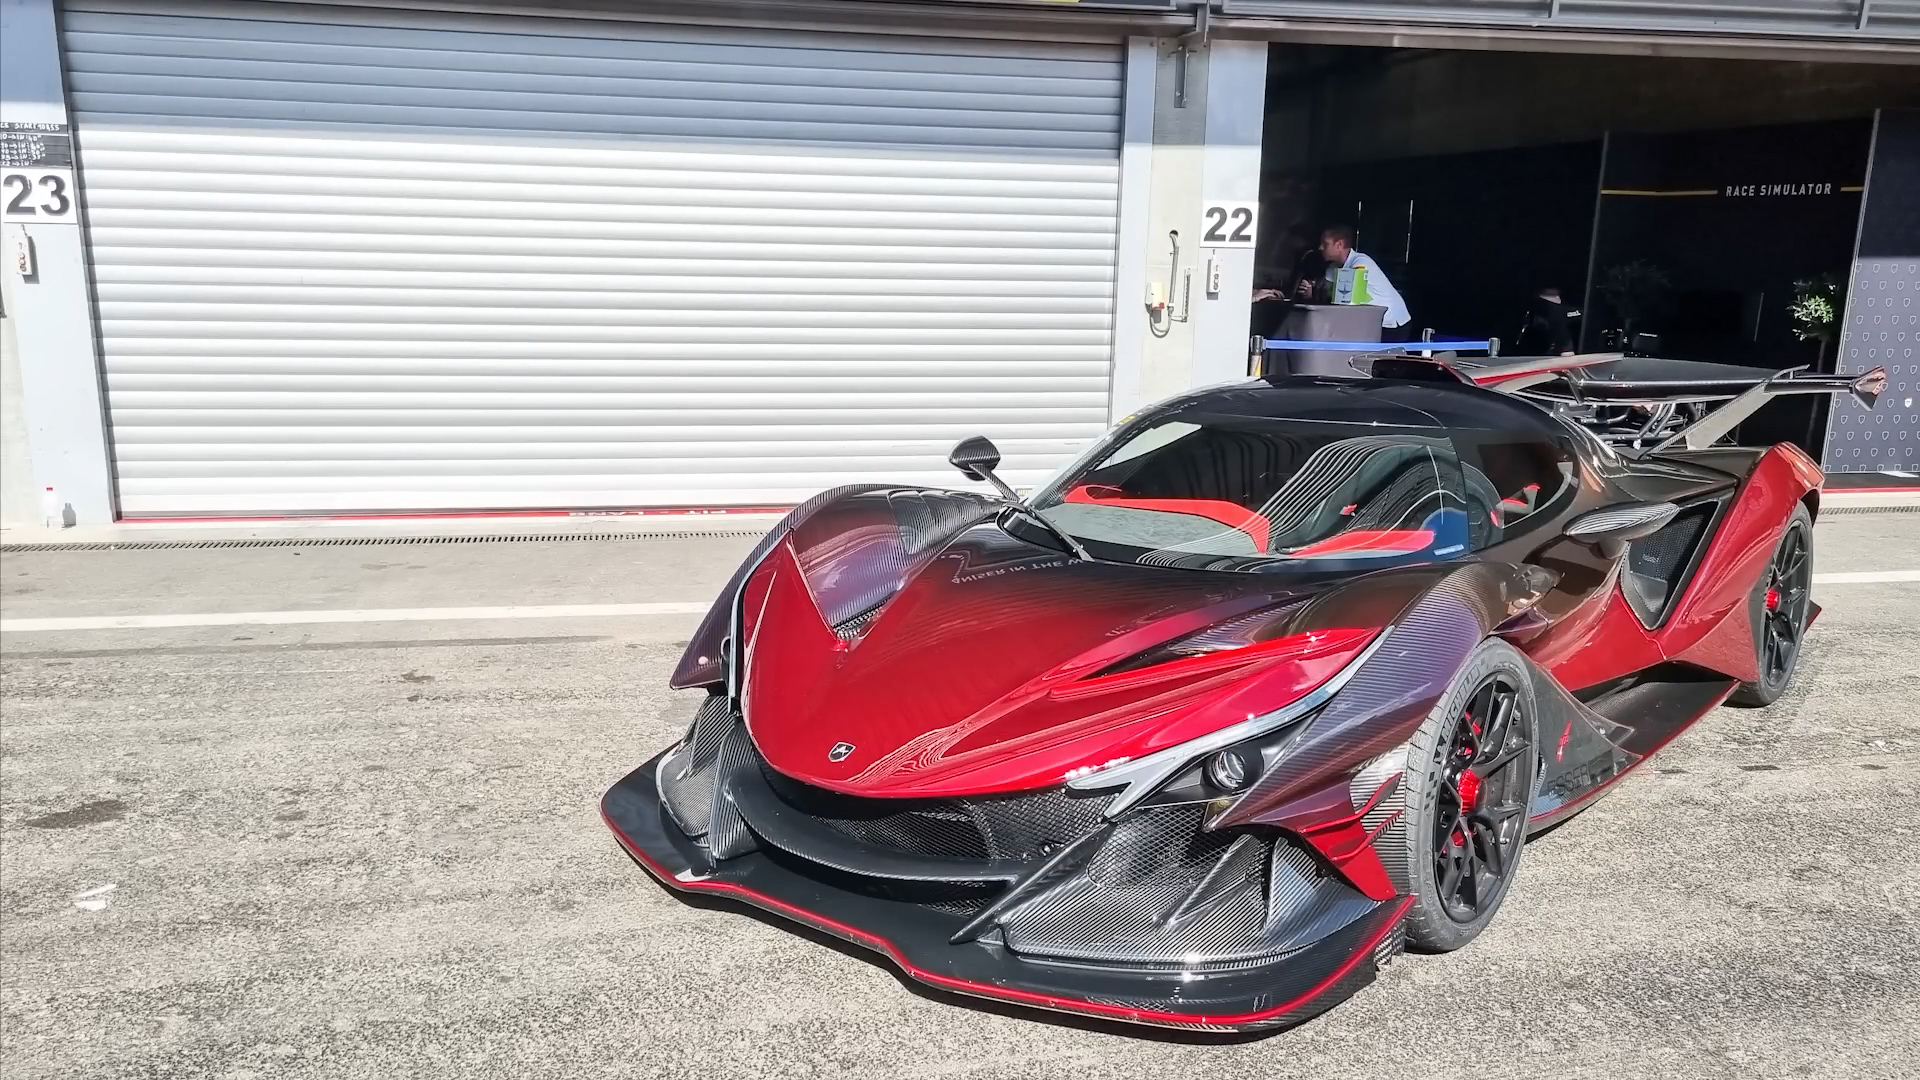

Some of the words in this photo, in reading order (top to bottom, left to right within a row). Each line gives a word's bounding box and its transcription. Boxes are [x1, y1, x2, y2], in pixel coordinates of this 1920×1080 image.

[3, 174, 70, 217] 23
[1725, 185, 1756, 197] RACE
[1759, 183, 1832, 196] SIMULATOR
[1203, 206, 1253, 242] 22
